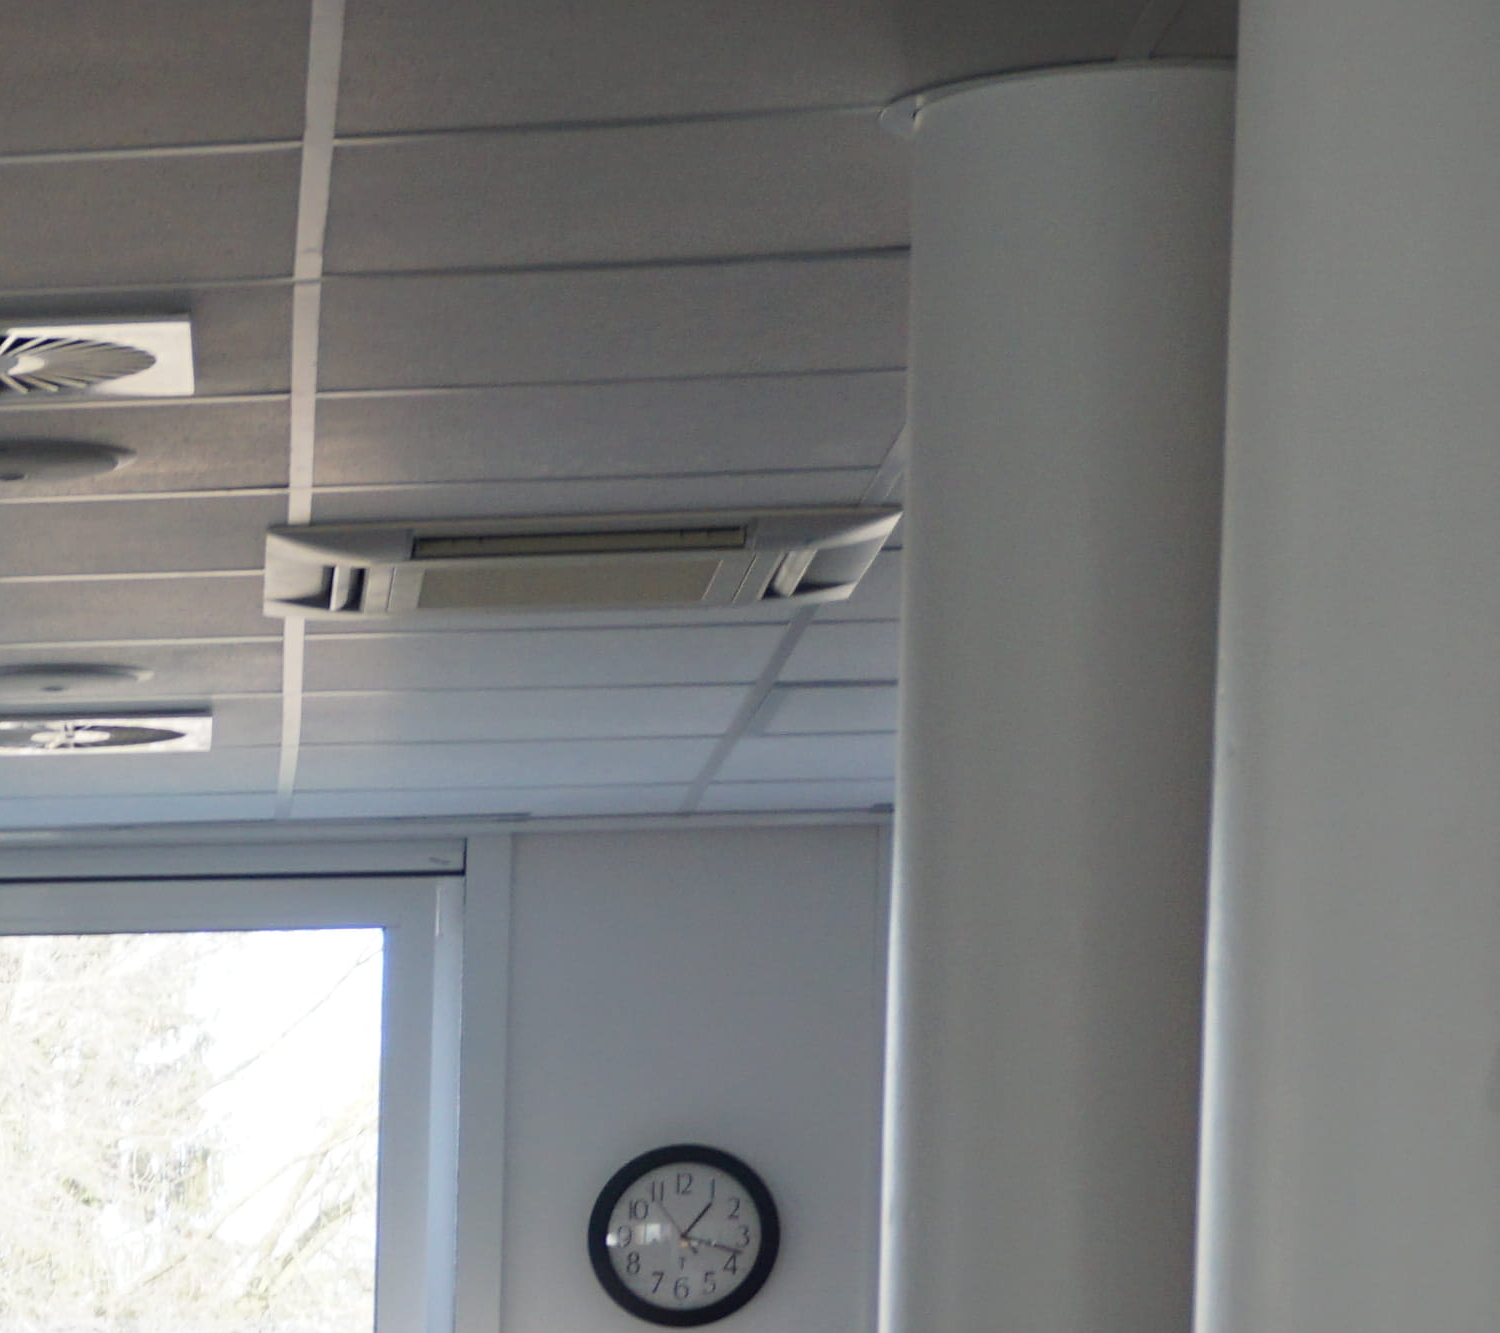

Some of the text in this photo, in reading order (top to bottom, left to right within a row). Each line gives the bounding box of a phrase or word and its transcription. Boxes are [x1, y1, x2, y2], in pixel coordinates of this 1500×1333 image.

[651, 1181, 664, 1202] 11
[676, 1174, 692, 1195] 12
[628, 1200, 649, 1220] 10
[727, 1198, 740, 1218] 2
[617, 1226, 632, 1248] 9
[736, 1225, 750, 1247] 3
[625, 1251, 640, 1274] 8
[723, 1252, 737, 1274] 4
[651, 1272, 664, 1293] 7
[673, 1277, 690, 1299] 6
[703, 1273, 717, 1293] 5
